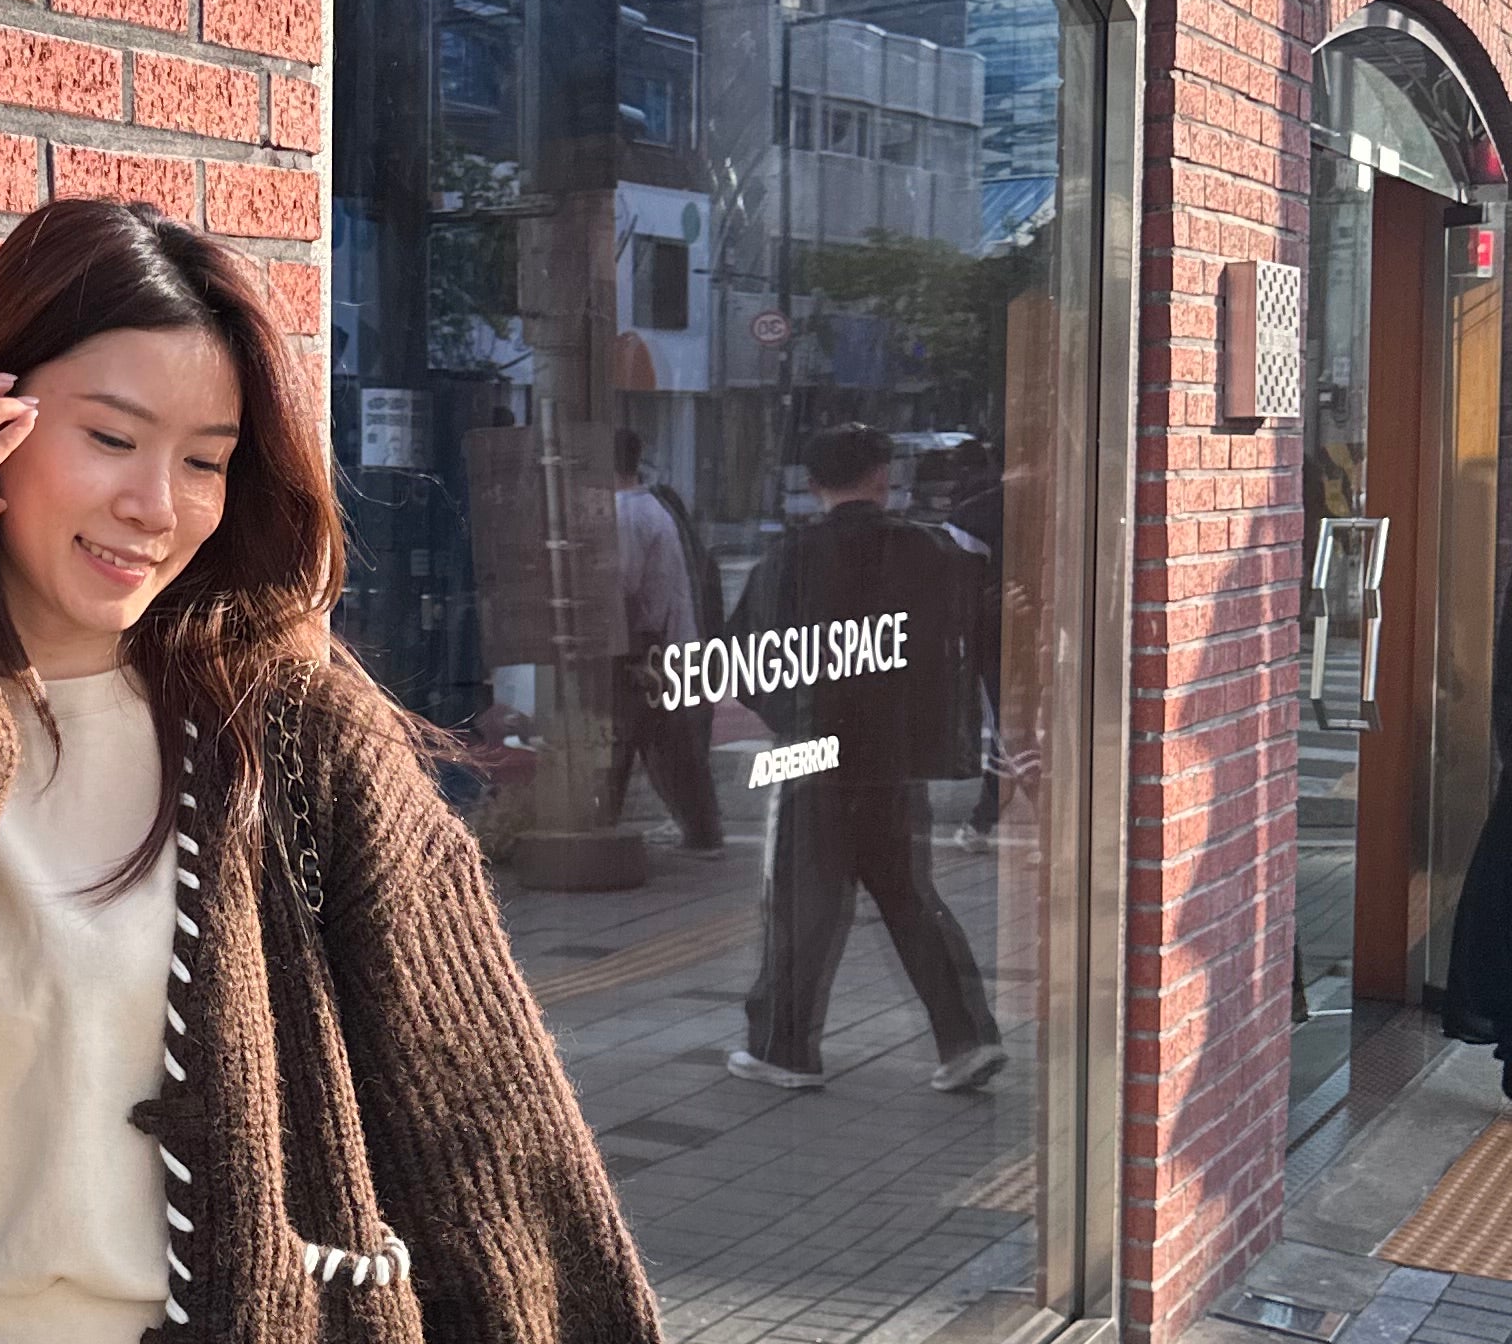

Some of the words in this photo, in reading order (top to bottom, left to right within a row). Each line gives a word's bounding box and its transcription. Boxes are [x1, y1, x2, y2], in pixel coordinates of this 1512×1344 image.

[662, 624, 820, 711] SEONGSU
[827, 611, 908, 681] SPACE
[748, 735, 840, 789] ADERERROR
